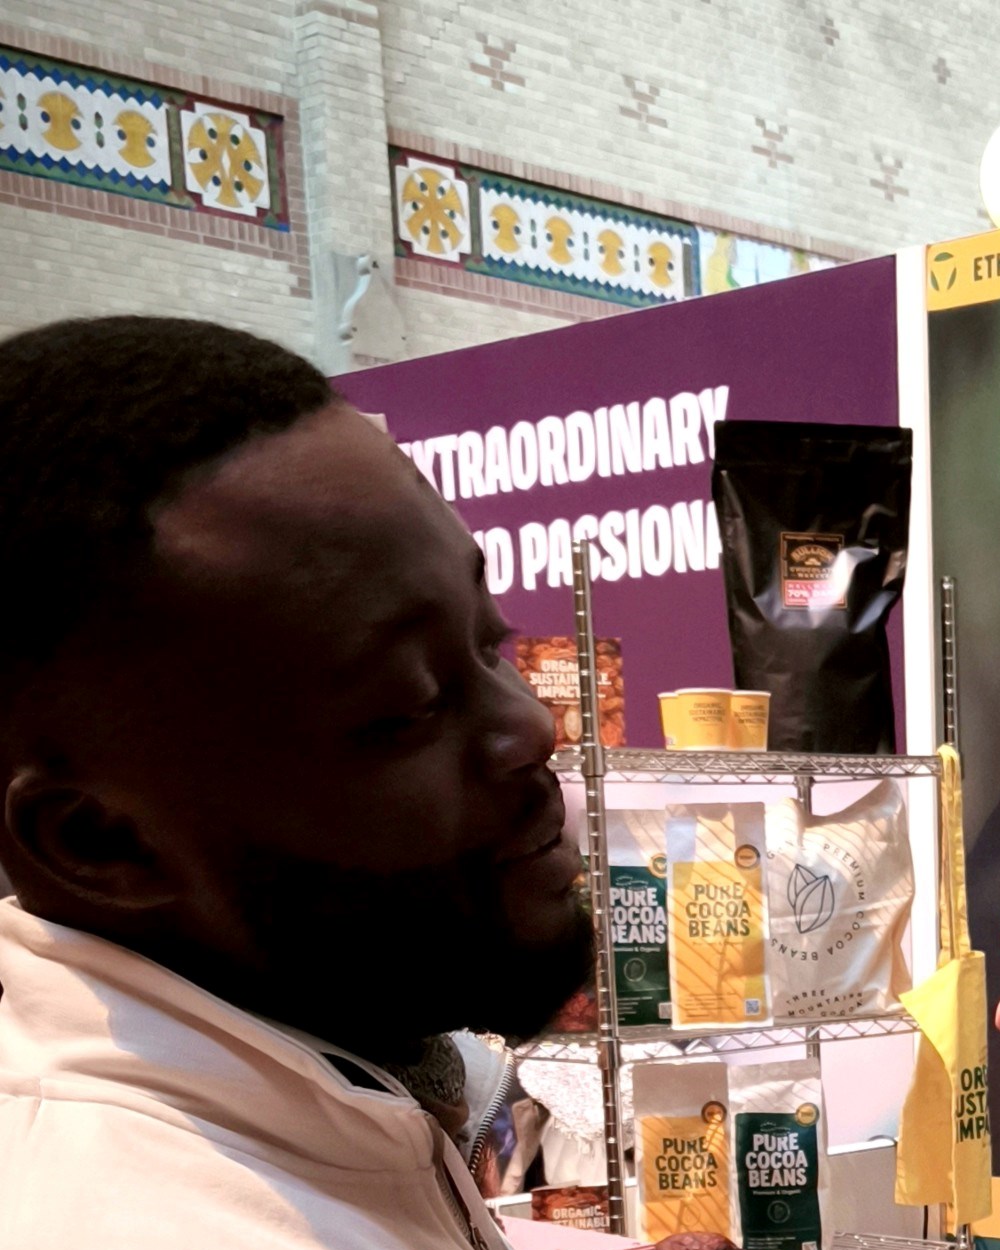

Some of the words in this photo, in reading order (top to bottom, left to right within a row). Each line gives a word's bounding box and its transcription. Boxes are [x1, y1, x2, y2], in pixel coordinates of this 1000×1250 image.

[472, 527, 515, 595] D
[541, 660, 580, 673] ORGA
[822, 842, 865, 901] PREMIUM
[610, 886, 658, 907] PURE
[694, 882, 744, 902] PURE
[611, 905, 667, 926] OCOA
[685, 900, 752, 920] COCOA
[688, 918, 750, 939] BEANS
[826, 910, 865, 956] COCOA
[771, 937, 819, 962] BEANS
[786, 989, 826, 1005] THREE
[960, 1064, 988, 1092] OR
[662, 1136, 709, 1155] PURE
[753, 1132, 799, 1152] PURE
[655, 1154, 718, 1172] COCOA
[745, 1149, 808, 1169] COCOA
[658, 1170, 717, 1190] BEANS
[748, 1167, 807, 1188] BEANS
